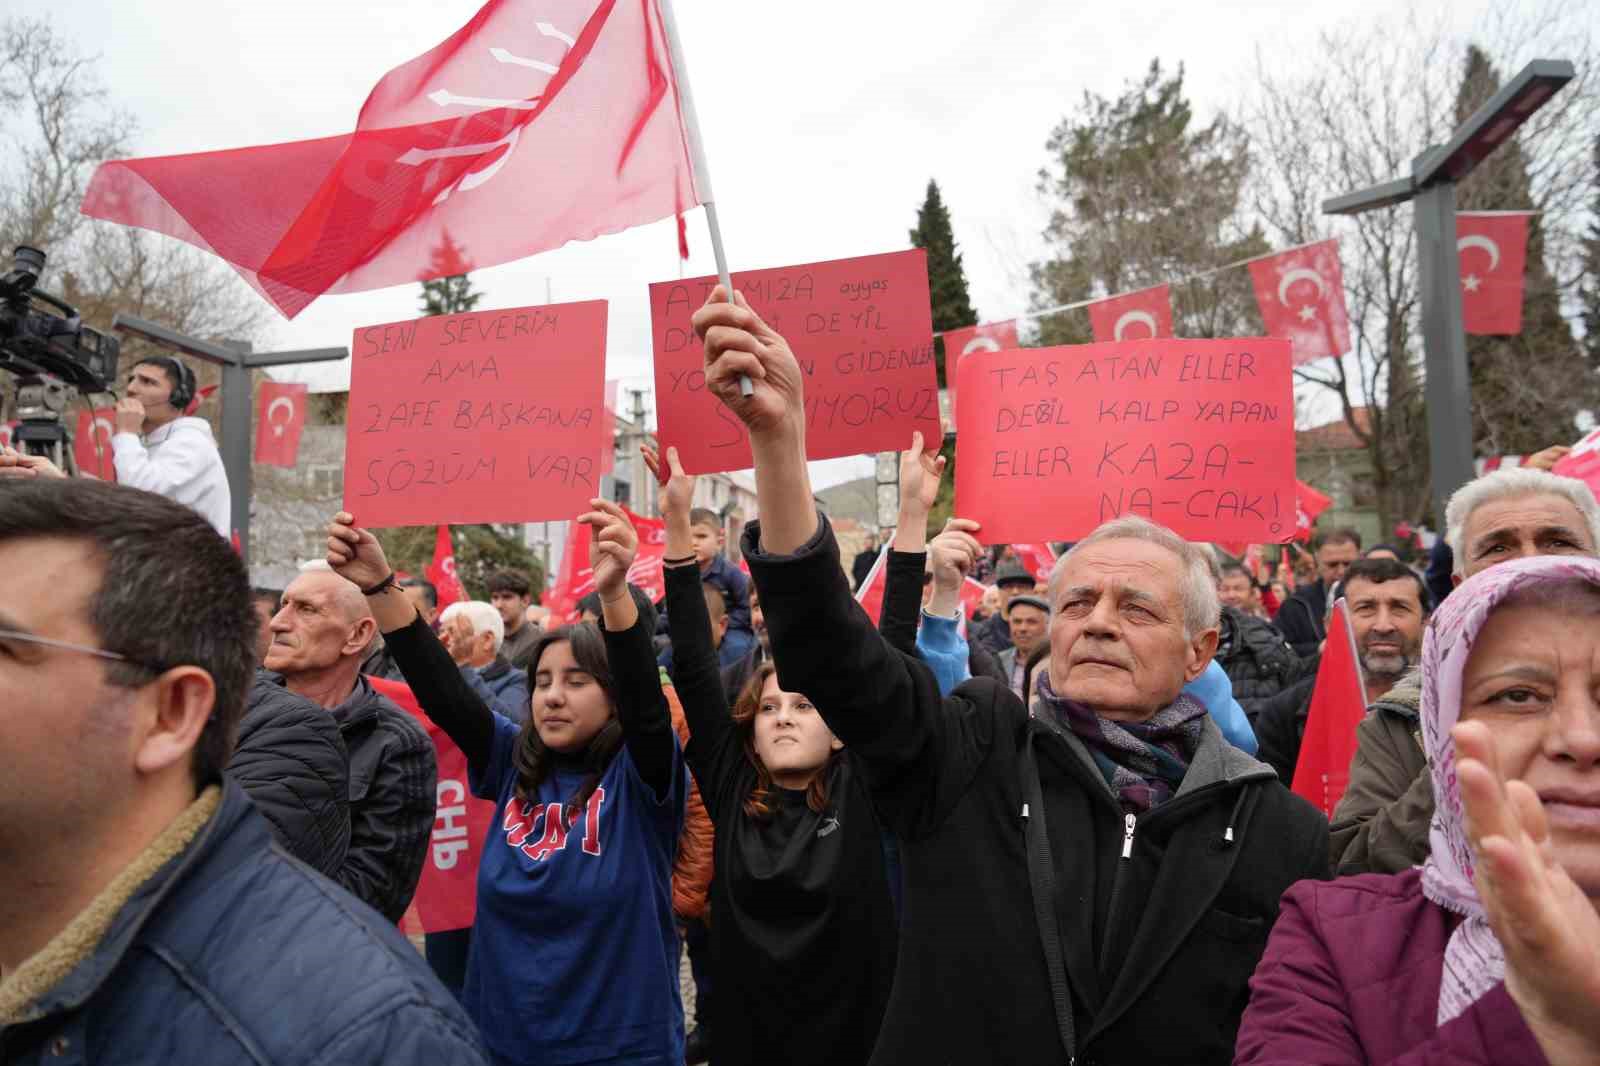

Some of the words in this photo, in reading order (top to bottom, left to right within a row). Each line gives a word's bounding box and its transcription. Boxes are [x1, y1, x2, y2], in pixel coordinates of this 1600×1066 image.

[665, 273, 815, 317] ATMIZA
[439, 311, 560, 347] SEVERİM
[805, 305, 889, 334] DEYİL
[421, 355, 499, 385] AMA
[988, 360, 1058, 393] TAŞ
[1075, 355, 1163, 384] ATAN
[1178, 352, 1258, 384] ELLER
[1098, 398, 1181, 424] KALP
[1192, 400, 1279, 422] YAPAN
[358, 447, 498, 498] SÖZÜM
[526, 454, 594, 489] VAR
[991, 444, 1073, 479] ELLER
